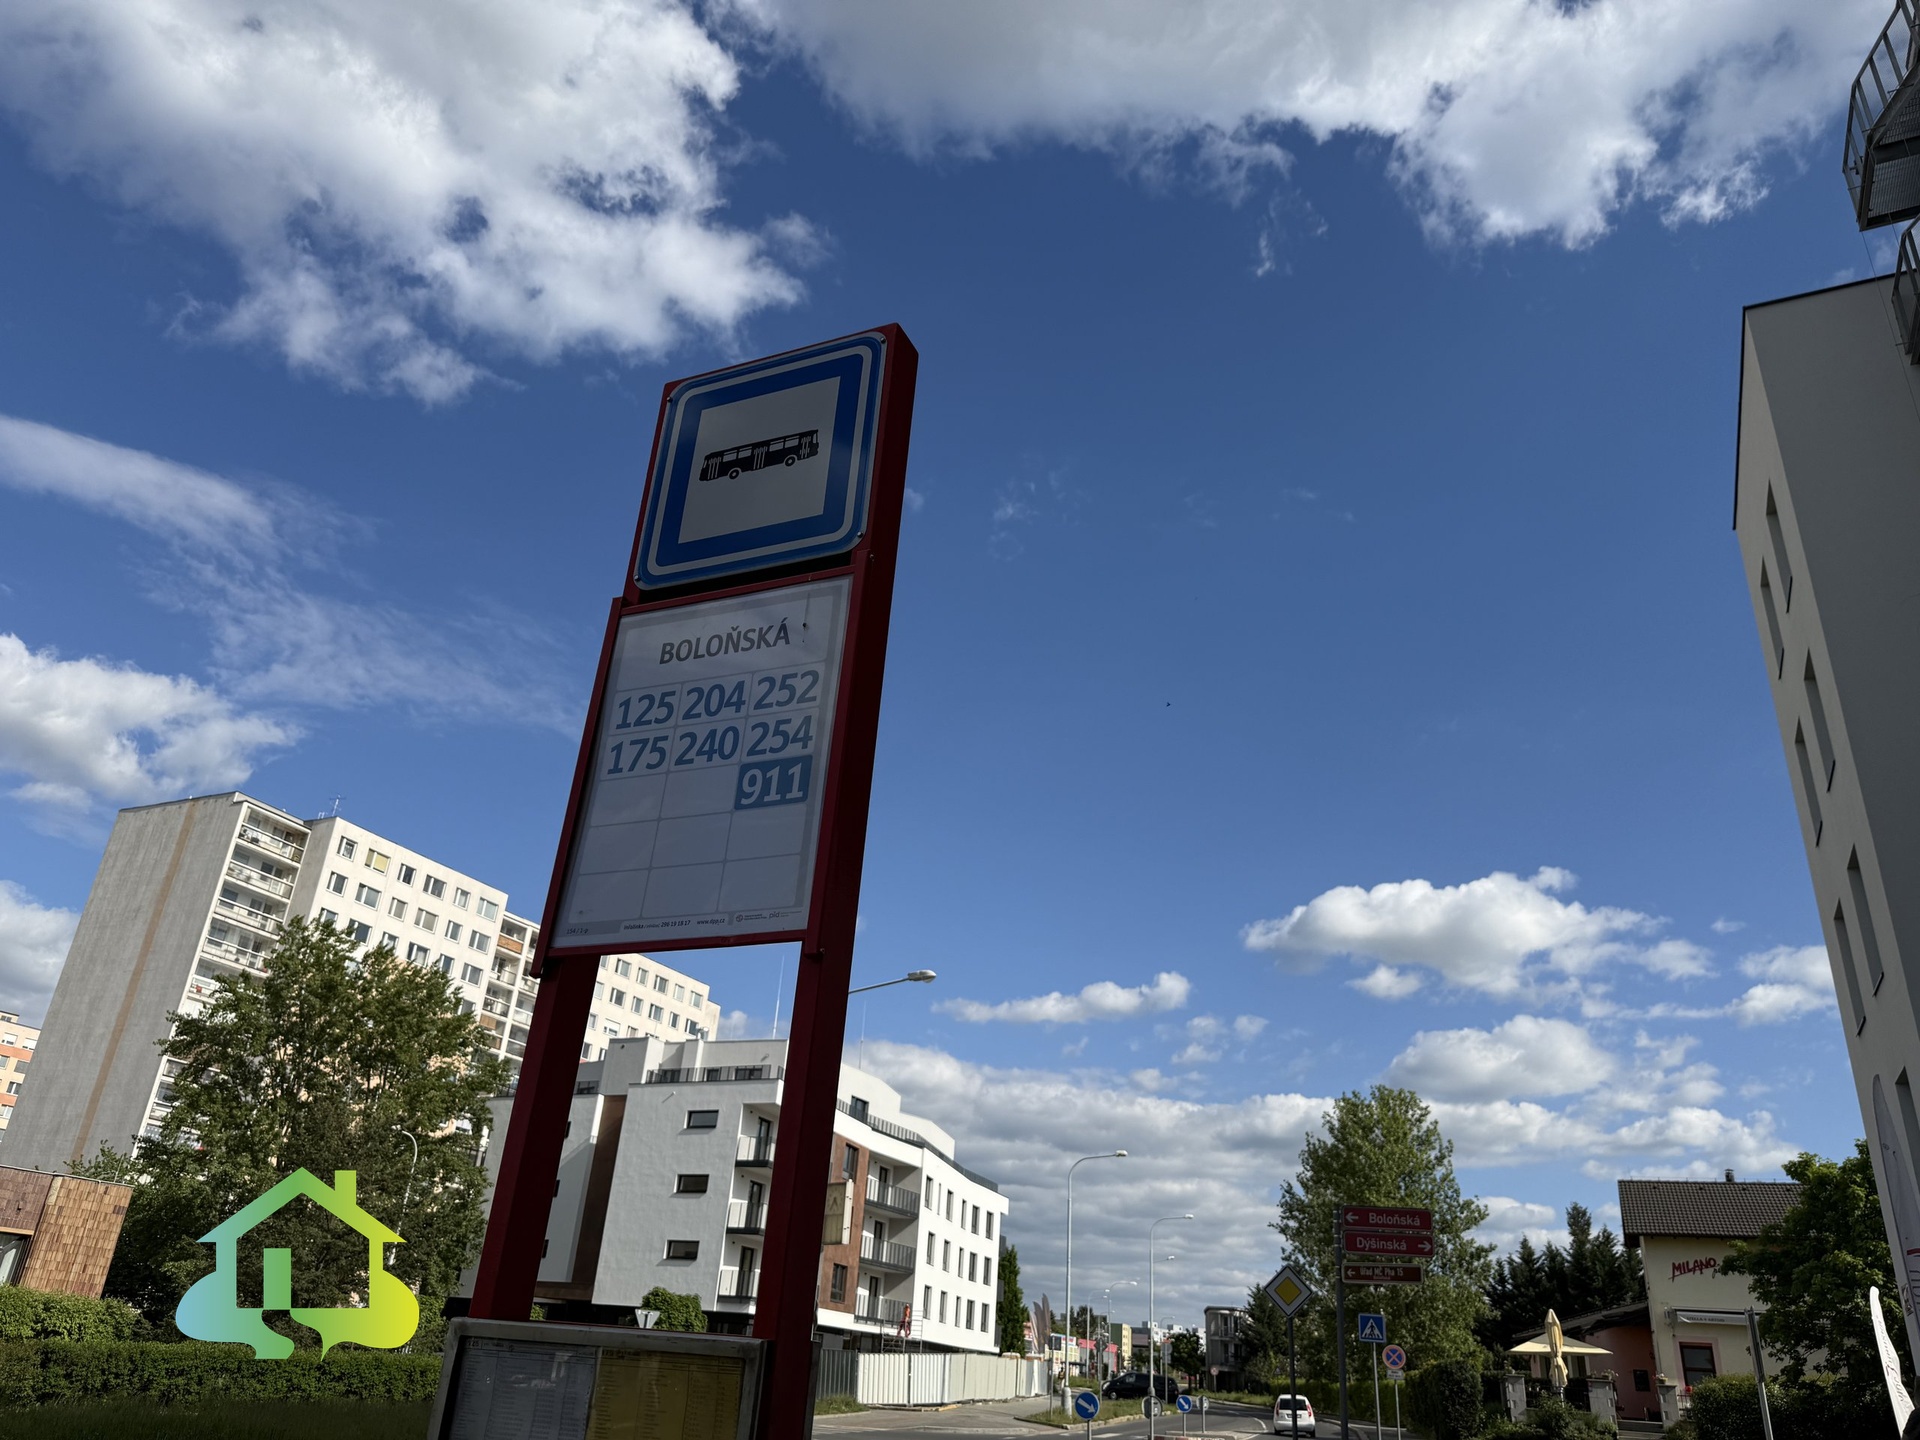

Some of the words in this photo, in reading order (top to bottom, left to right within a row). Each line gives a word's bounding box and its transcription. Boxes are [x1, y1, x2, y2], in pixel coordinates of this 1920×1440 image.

[659, 616, 790, 665] BOLOŇSKÁ
[615, 690, 676, 730] 125
[681, 680, 746, 721] 204
[753, 669, 820, 710] 252
[607, 735, 669, 775] 175
[674, 725, 740, 767] 240
[746, 714, 814, 757] 254
[740, 761, 804, 805] 911
[1368, 1212, 1421, 1226] Boloňská
[1356, 1236, 1407, 1251] Dýšinská
[1397, 1267, 1404, 1277] 15
[1669, 1257, 1717, 1281] MILANO
